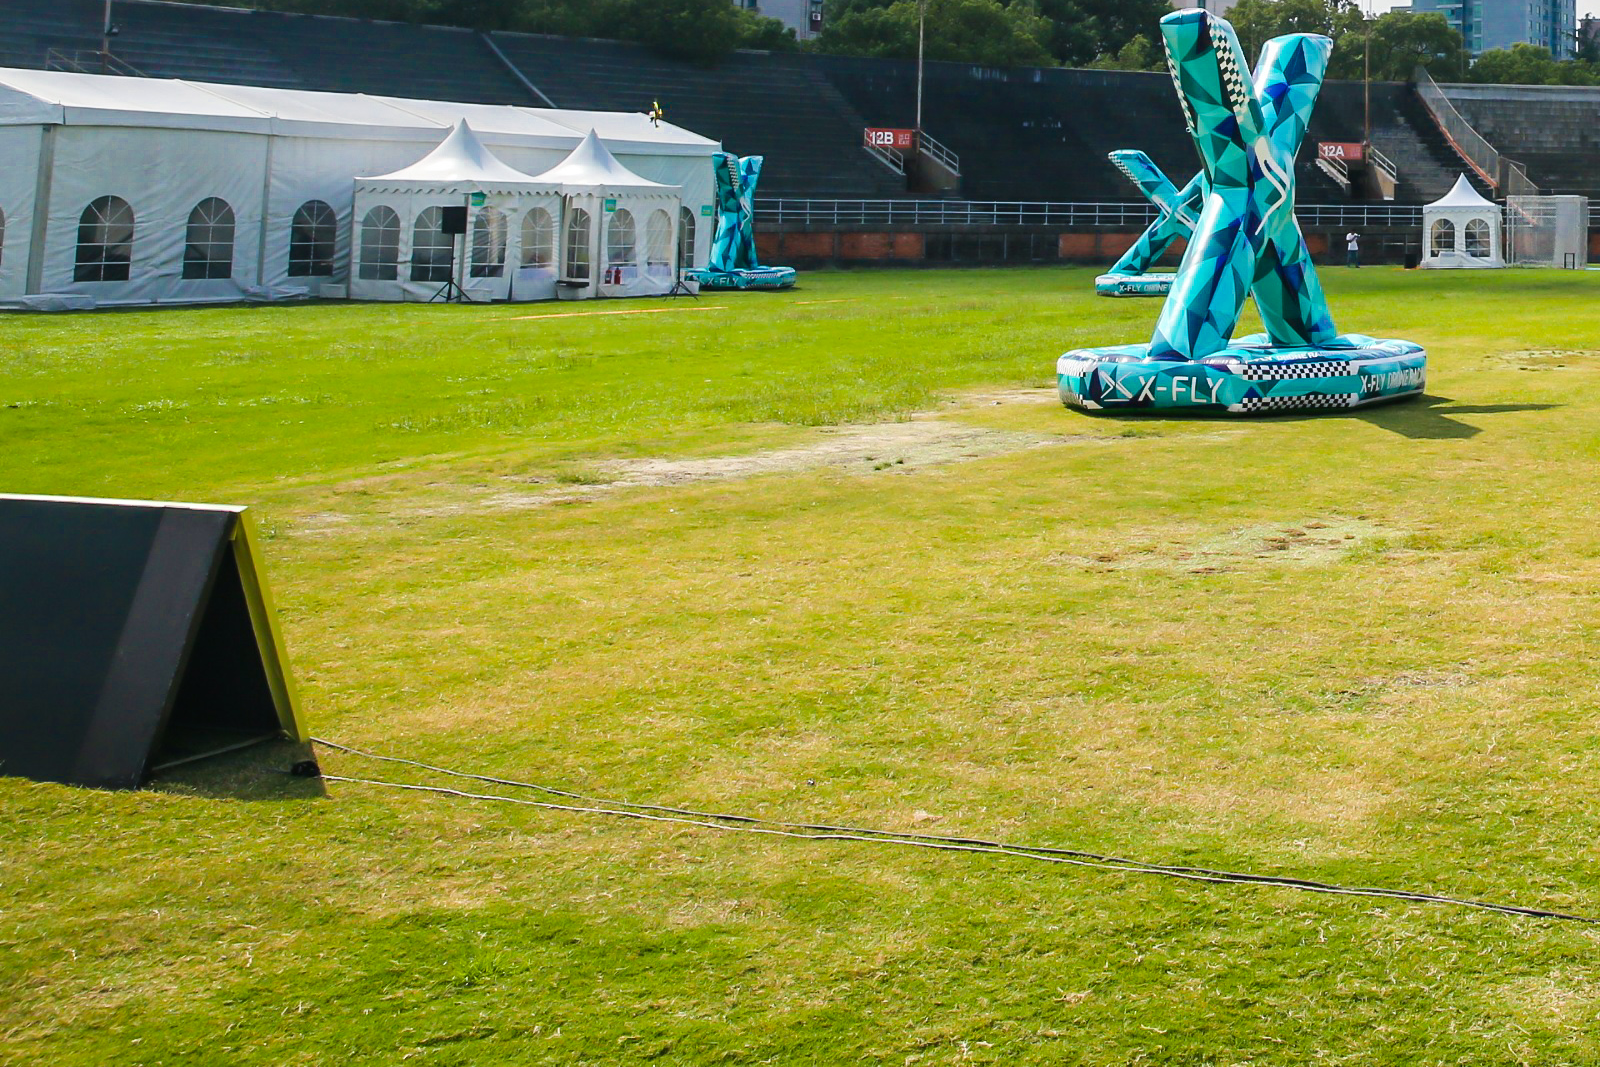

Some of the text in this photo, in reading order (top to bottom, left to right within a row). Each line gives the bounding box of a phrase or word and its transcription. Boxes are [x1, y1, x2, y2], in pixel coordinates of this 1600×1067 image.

[870, 131, 894, 145] 12B
[1323, 145, 1345, 157] 12A
[708, 277, 739, 286] X-FLY
[1119, 284, 1141, 292] X-FLY
[1136, 375, 1225, 404] X-FLY
[1360, 373, 1386, 394] X-FLY
